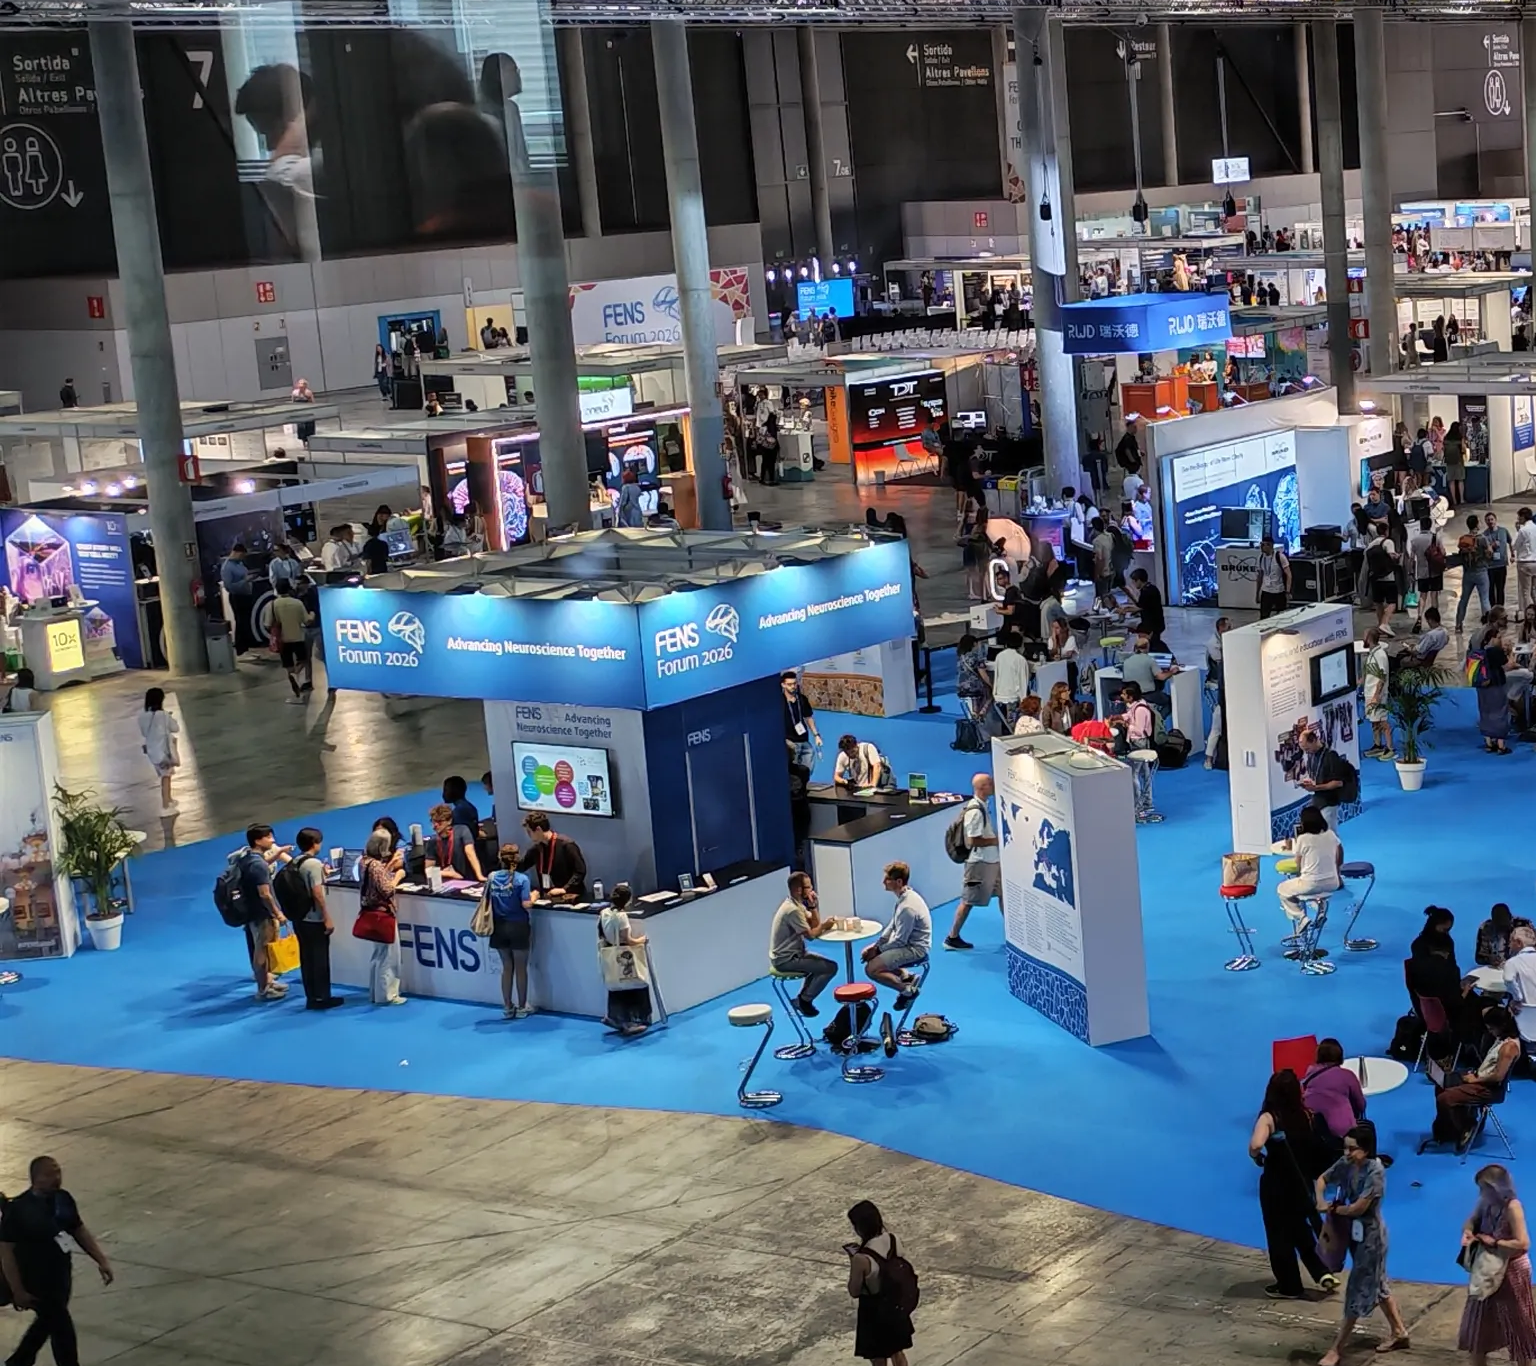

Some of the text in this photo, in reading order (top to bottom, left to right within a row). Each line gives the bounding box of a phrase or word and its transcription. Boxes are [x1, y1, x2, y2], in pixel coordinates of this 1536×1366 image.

[923, 44, 953, 56] Sortida
[13, 55, 70, 71] Sortida
[925, 66, 990, 78] Altres Pavellons
[184, 50, 214, 109] 7
[18, 87, 68, 103] Altres
[603, 300, 646, 328] FENS
[605, 326, 681, 344] Forum 2026
[889, 381, 918, 397] TDT
[1221, 563, 1257, 573] BRUKE
[759, 583, 901, 629] Advancing Neuroscience Together
[53, 632, 77, 647] 10x
[336, 620, 381, 645] FENS
[655, 623, 699, 656] FENS
[339, 646, 419, 667] Forum 2026
[447, 636, 626, 661] Advancing Neuroscience Together
[657, 642, 733, 678] Forum 2026
[516, 706, 611, 727] FENS Advancing
[517, 722, 612, 739] Neuroscience Together
[687, 728, 711, 746] FENS
